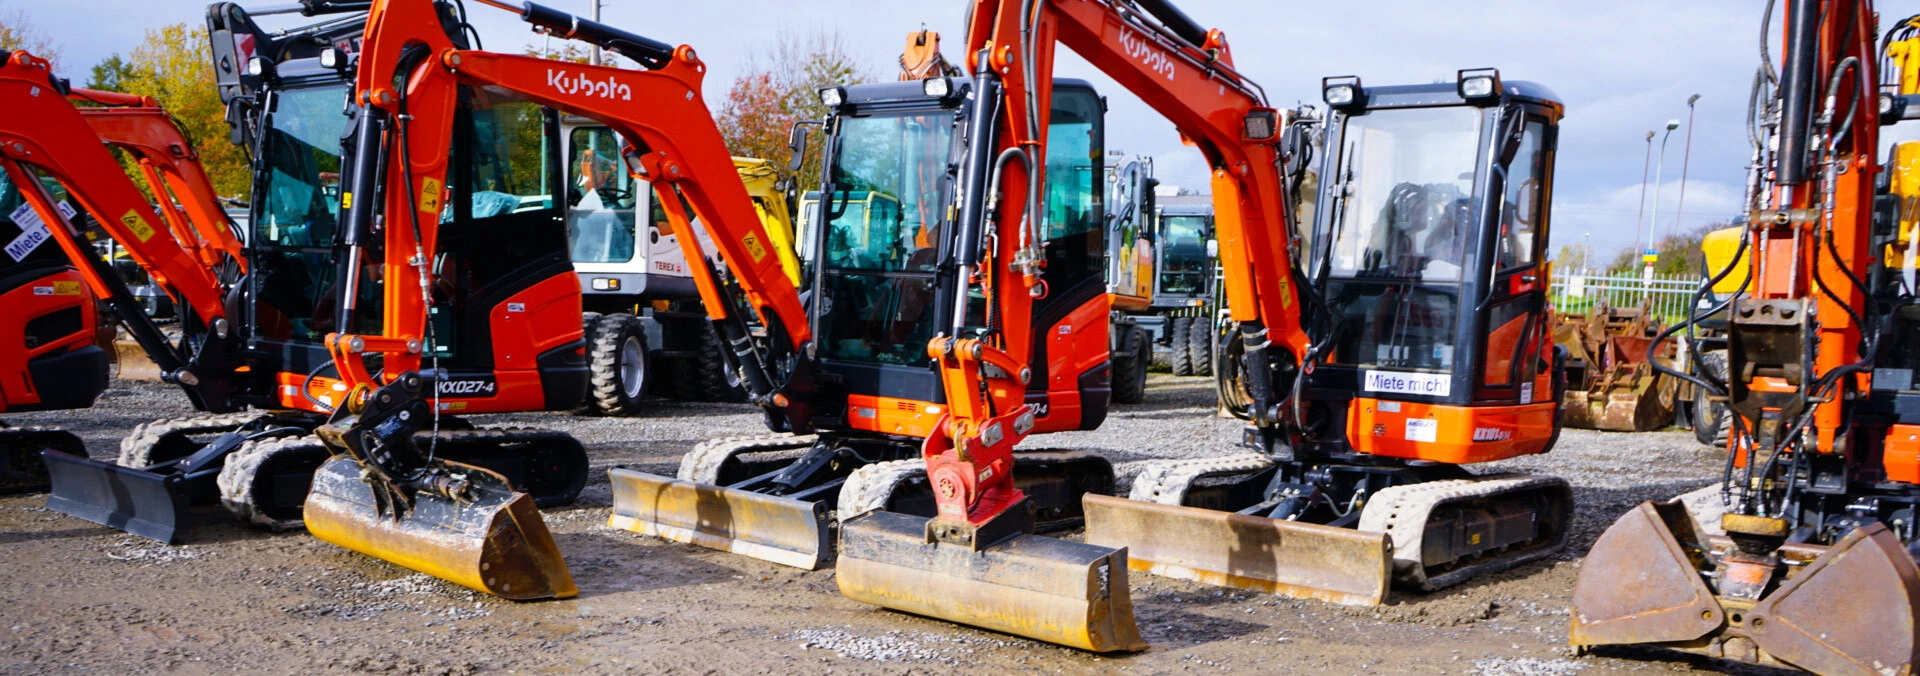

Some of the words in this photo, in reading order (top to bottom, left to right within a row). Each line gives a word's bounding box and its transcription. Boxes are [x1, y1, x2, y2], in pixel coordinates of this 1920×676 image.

[1119, 25, 1174, 81] Kubota
[547, 69, 631, 100] Kubota
[8, 231, 43, 259] Miete
[654, 261, 675, 272] TEREX
[439, 381, 494, 393] KX027-4
[1368, 374, 1404, 390] Miete
[1408, 377, 1447, 393] mich!
